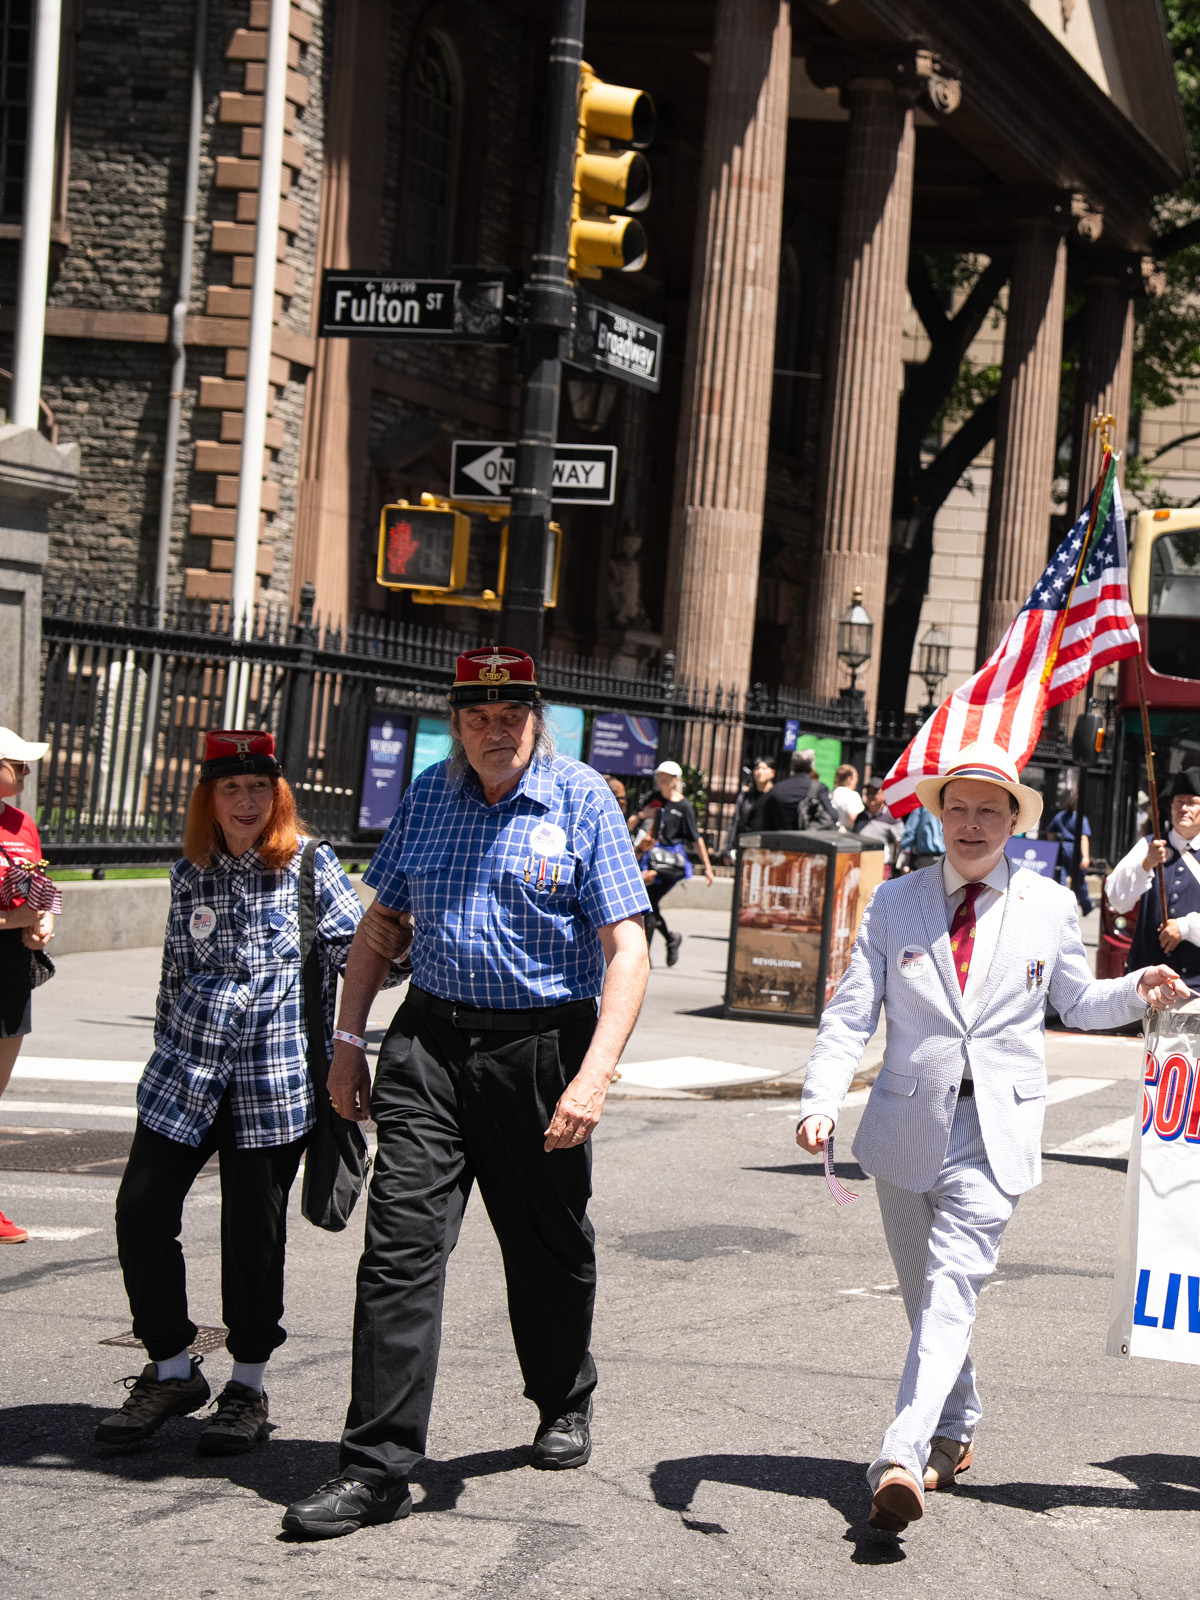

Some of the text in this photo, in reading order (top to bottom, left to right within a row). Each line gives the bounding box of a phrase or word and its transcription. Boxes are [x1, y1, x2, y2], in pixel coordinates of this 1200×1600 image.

[334, 290, 444, 324] Fulton ST
[598, 322, 655, 375] Broadway
[484, 460, 595, 484] ON WAY
[236, 741, 250, 753] H
[752, 956, 803, 969] REVOLUTION
